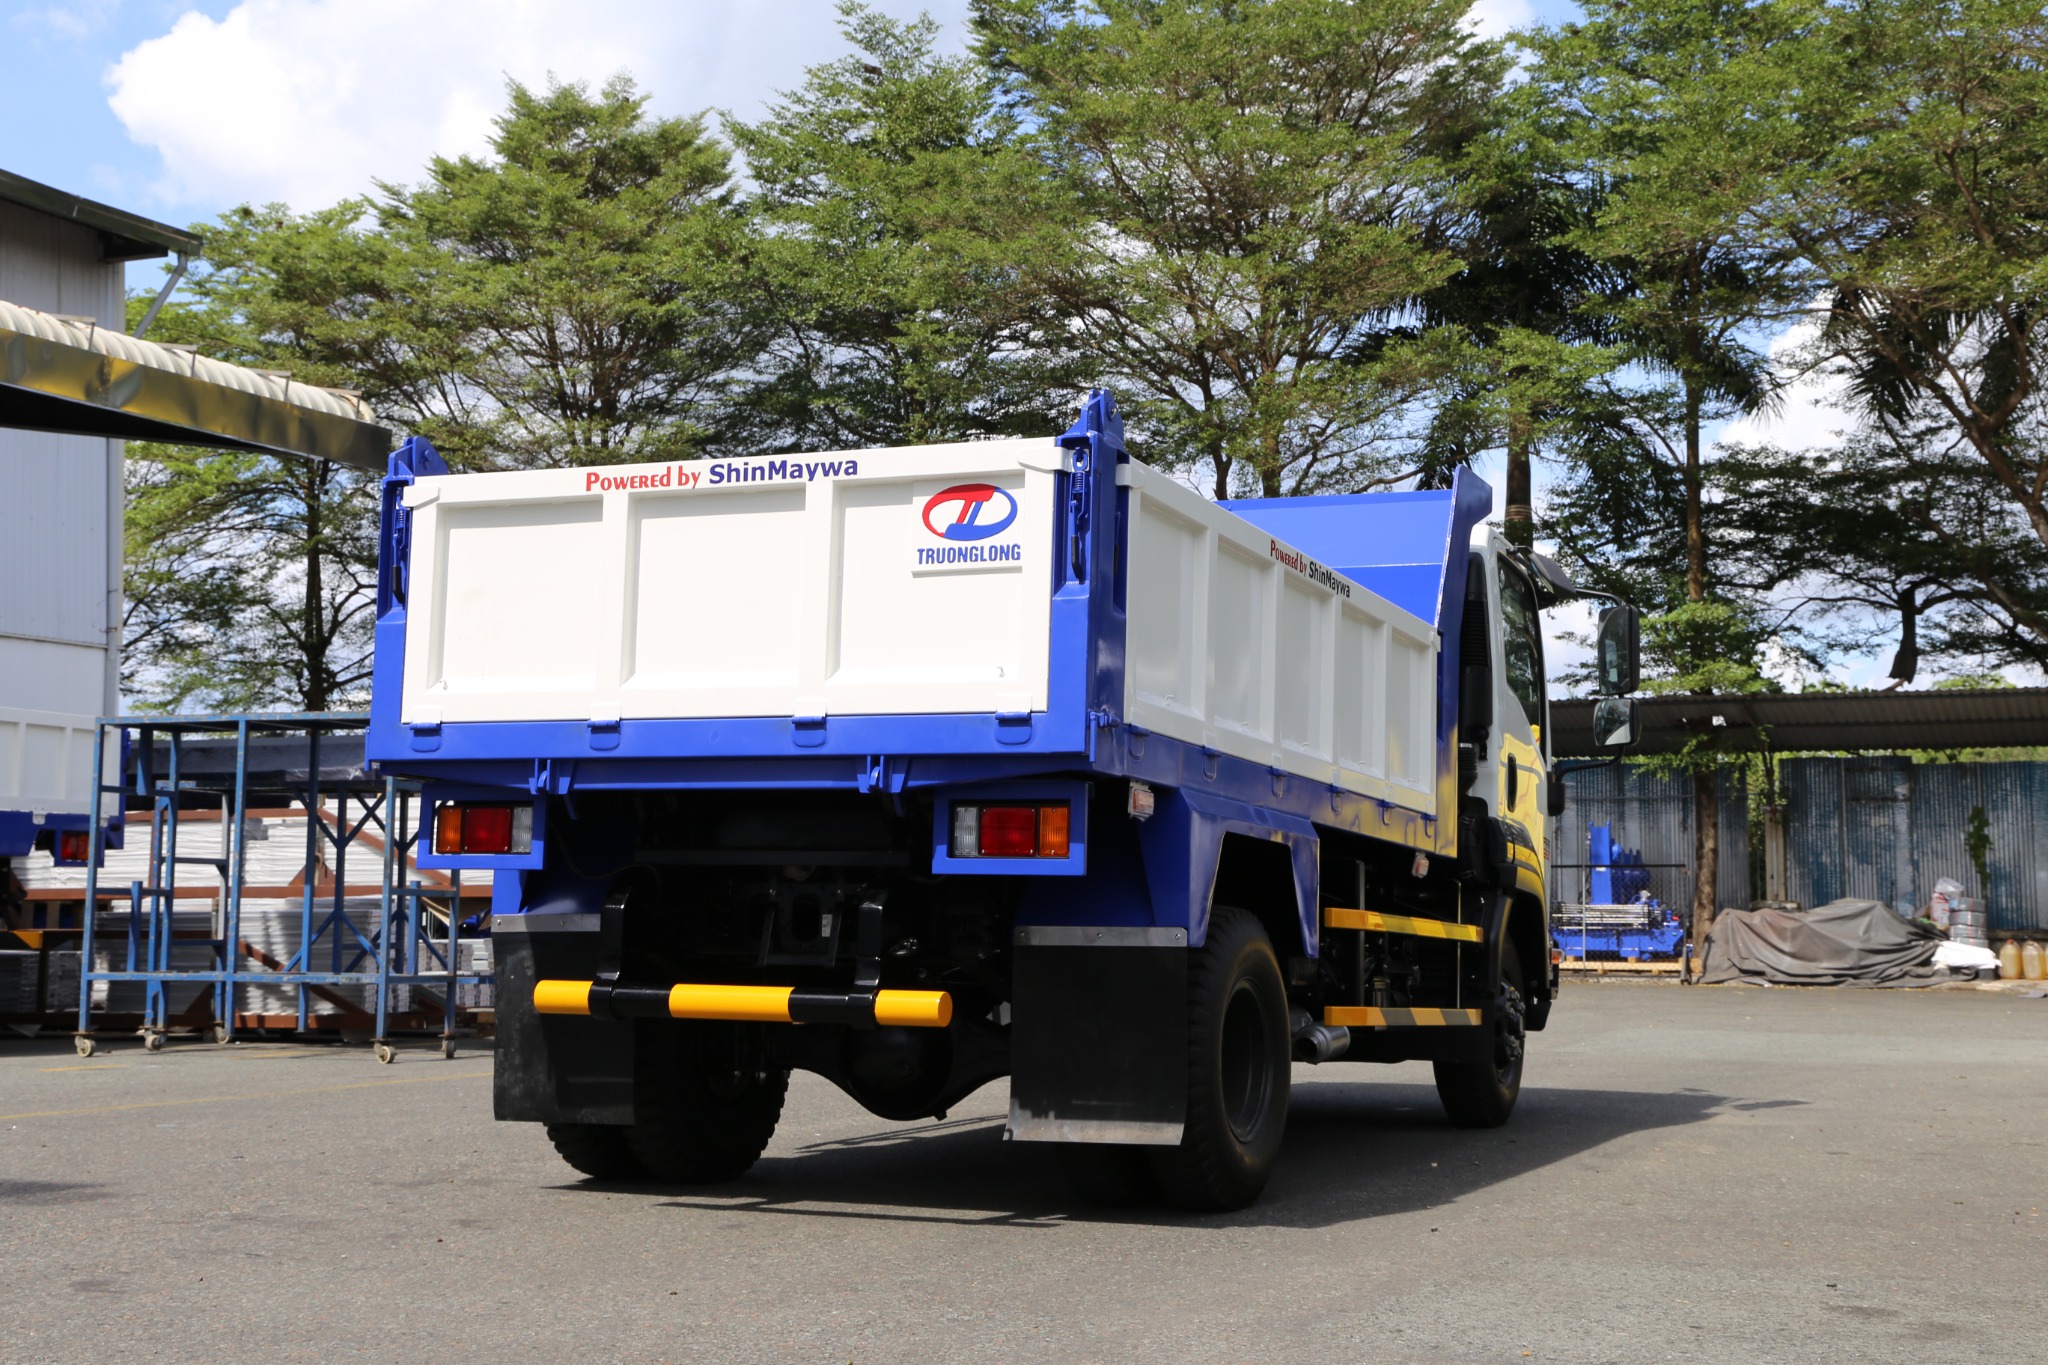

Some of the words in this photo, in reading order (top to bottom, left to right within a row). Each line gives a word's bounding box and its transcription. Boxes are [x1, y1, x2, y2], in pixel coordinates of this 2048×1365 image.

[678, 465, 701, 489] by
[709, 460, 858, 484] ShinMaywa
[917, 543, 1021, 565] TRUONGLONG
[1299, 554, 1308, 577] by
[1308, 560, 1351, 598] ShinMaywa
